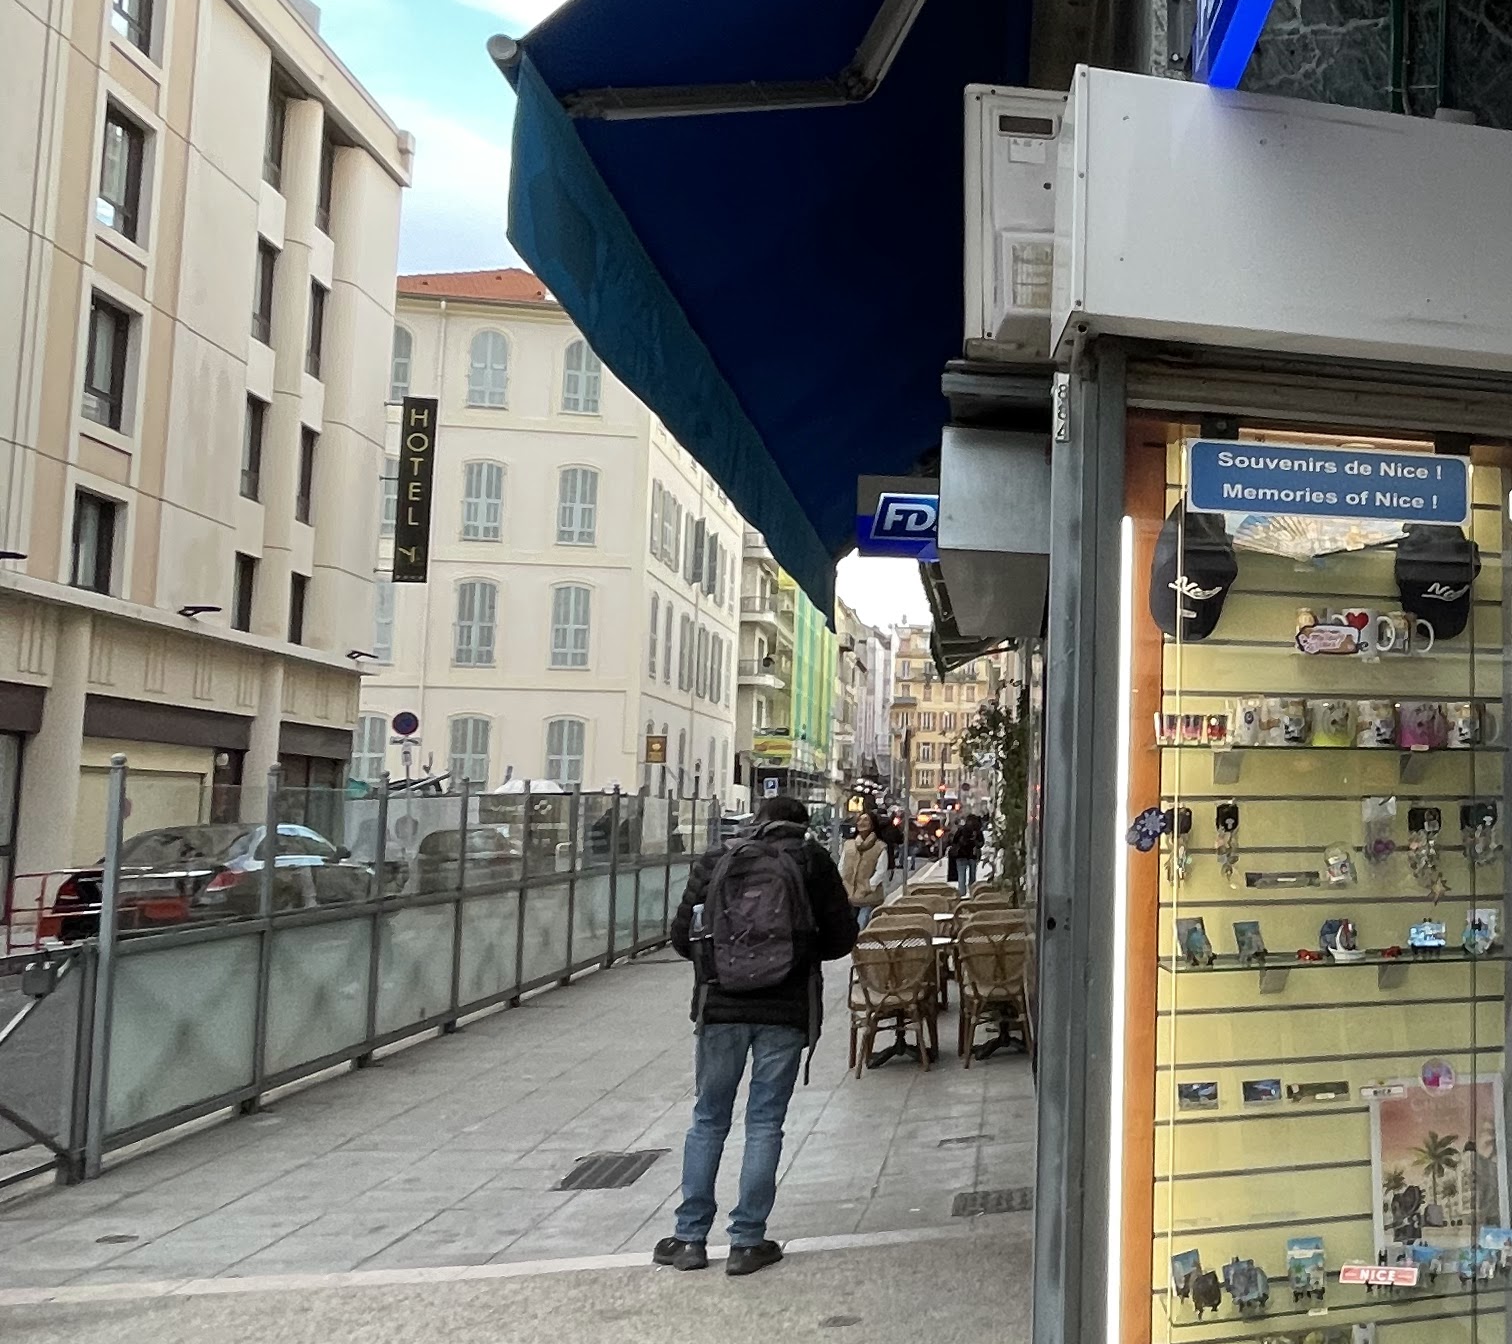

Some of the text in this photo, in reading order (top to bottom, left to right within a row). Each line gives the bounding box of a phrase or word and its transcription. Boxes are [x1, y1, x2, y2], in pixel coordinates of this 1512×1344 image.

[406, 408, 429, 526] HOTEL
[1217, 451, 1337, 474] Souvenirs
[1345, 460, 1371, 476] de
[1380, 462, 1428, 479] Nice
[1222, 483, 1338, 504] Memories
[1345, 490, 1369, 505] of
[1375, 492, 1424, 509] Nice
[882, 502, 938, 532] FD
[1359, 1268, 1396, 1282] NICE
